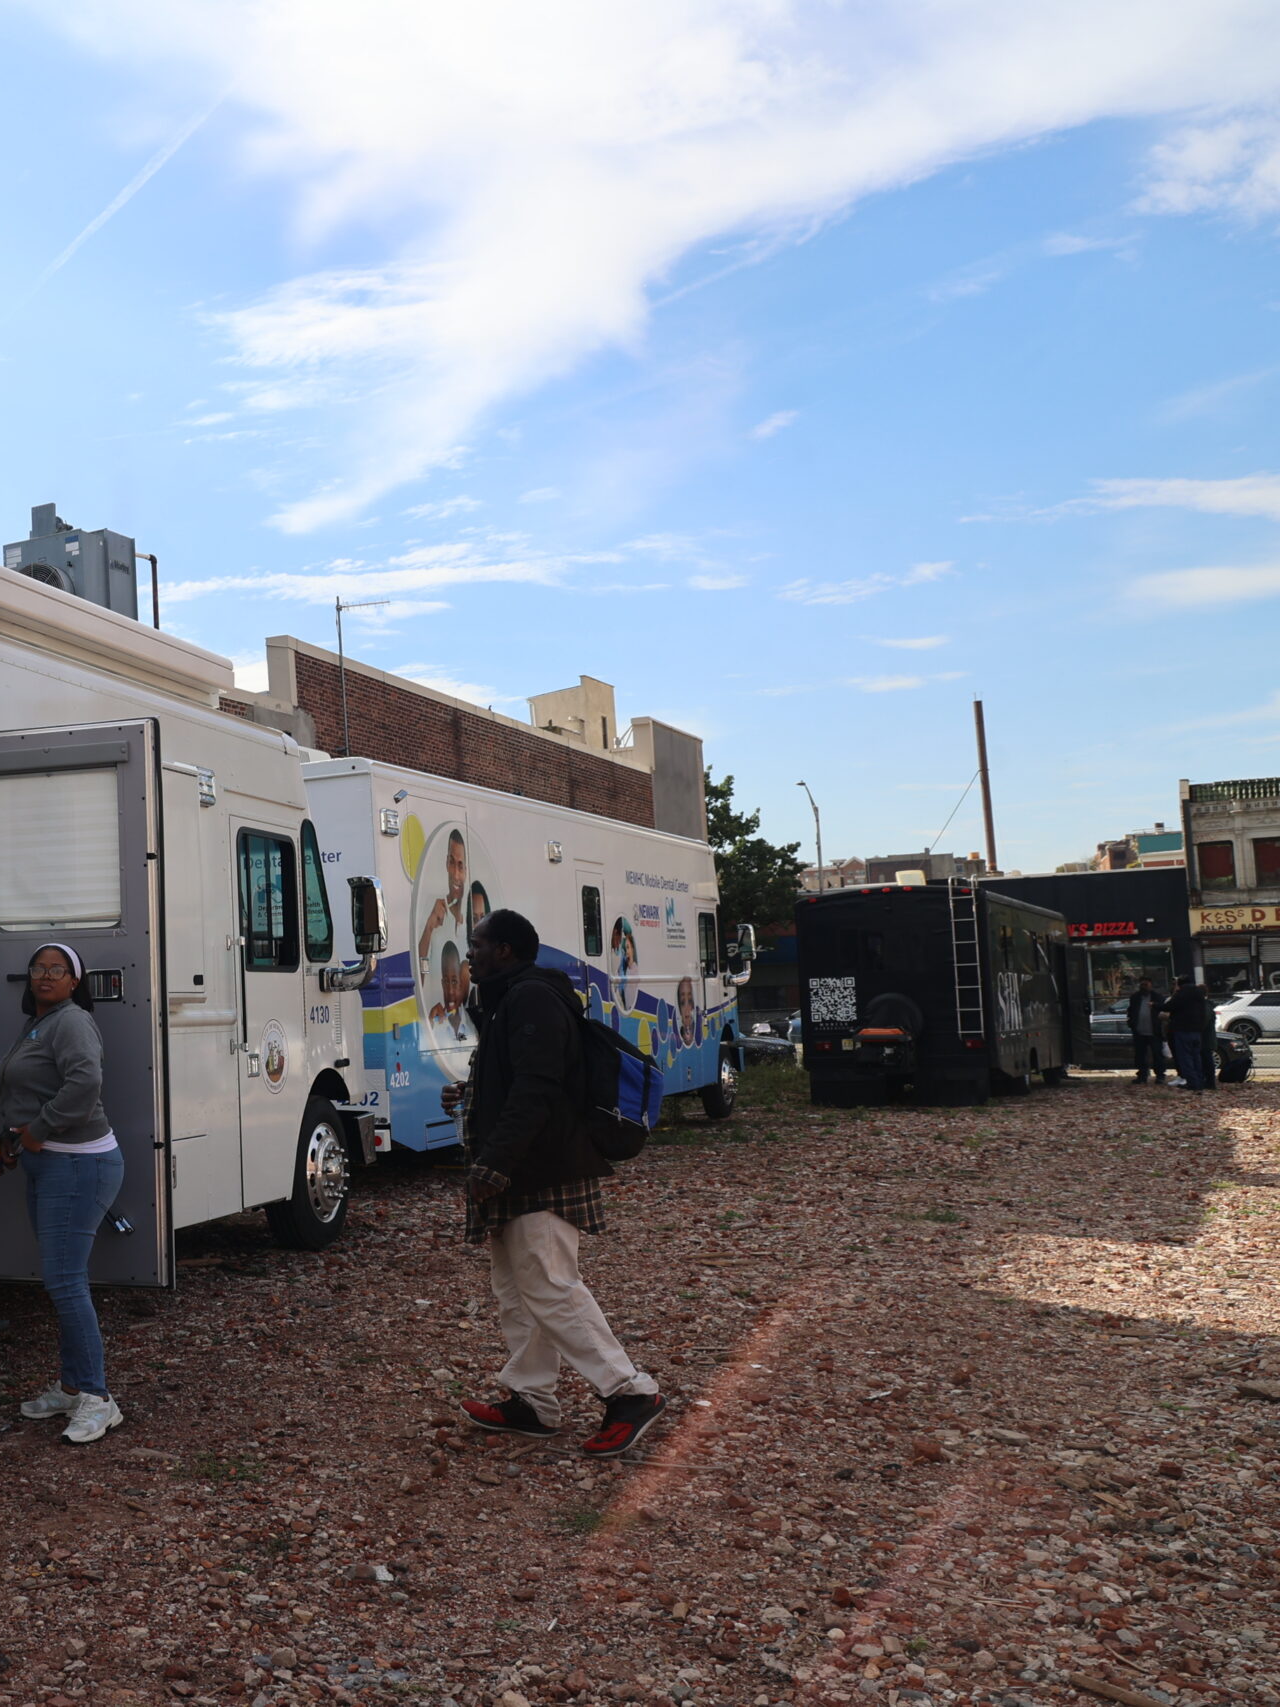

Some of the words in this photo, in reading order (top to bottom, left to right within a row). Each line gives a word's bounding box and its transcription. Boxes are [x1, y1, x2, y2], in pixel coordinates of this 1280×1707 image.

[639, 904, 660, 920] NEWARK
[1093, 921, 1138, 936] PIZZA
[309, 1005, 330, 1024] 4130
[389, 1071, 410, 1088] 4202
